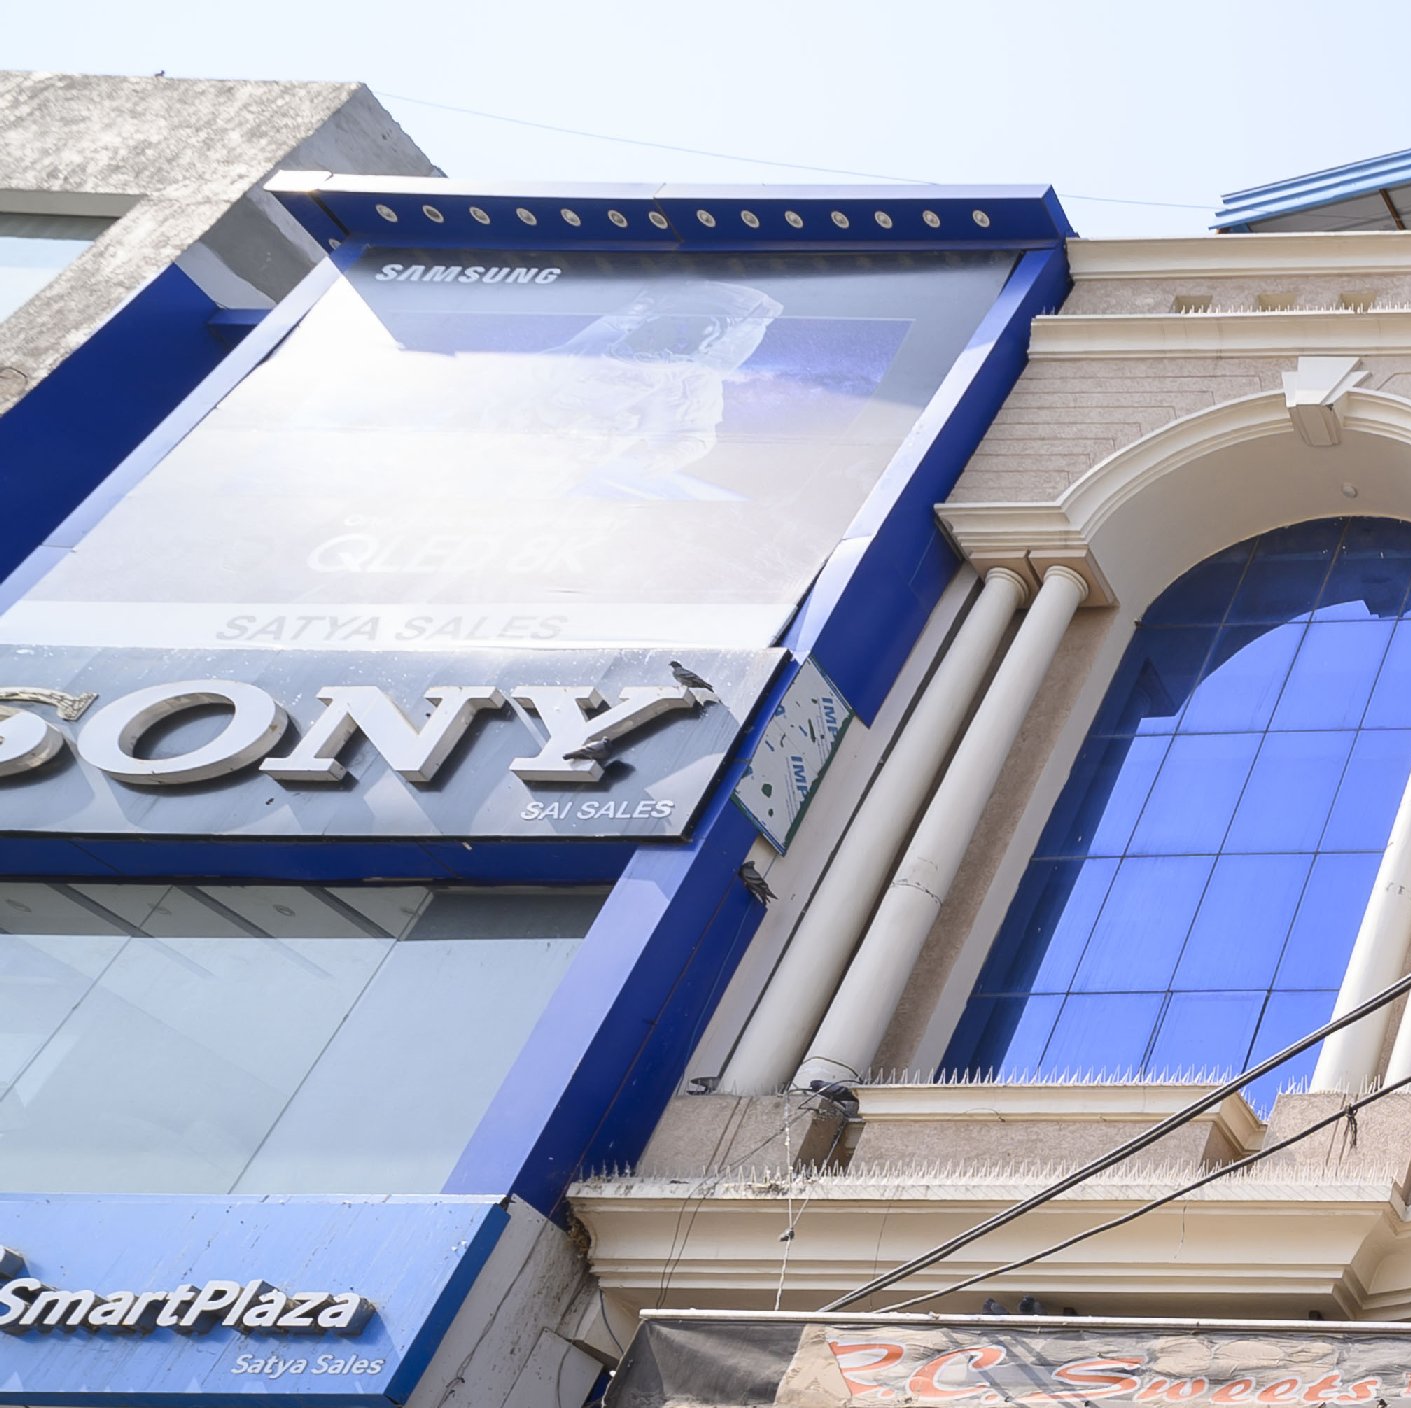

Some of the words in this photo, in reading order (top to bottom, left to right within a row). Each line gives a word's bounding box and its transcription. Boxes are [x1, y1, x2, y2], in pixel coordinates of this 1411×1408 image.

[375, 263, 562, 286] SAMSUNG
[215, 615, 382, 641] SATYA
[394, 615, 569, 641] SALES
[520, 801, 571, 820] SAI
[577, 800, 674, 820] SALES
[0, 1279, 373, 1336] SmartPlaza
[231, 1353, 308, 1378] Satya
[310, 1354, 385, 1376] Sales
[1006, 1354, 1379, 1405] Sweets
